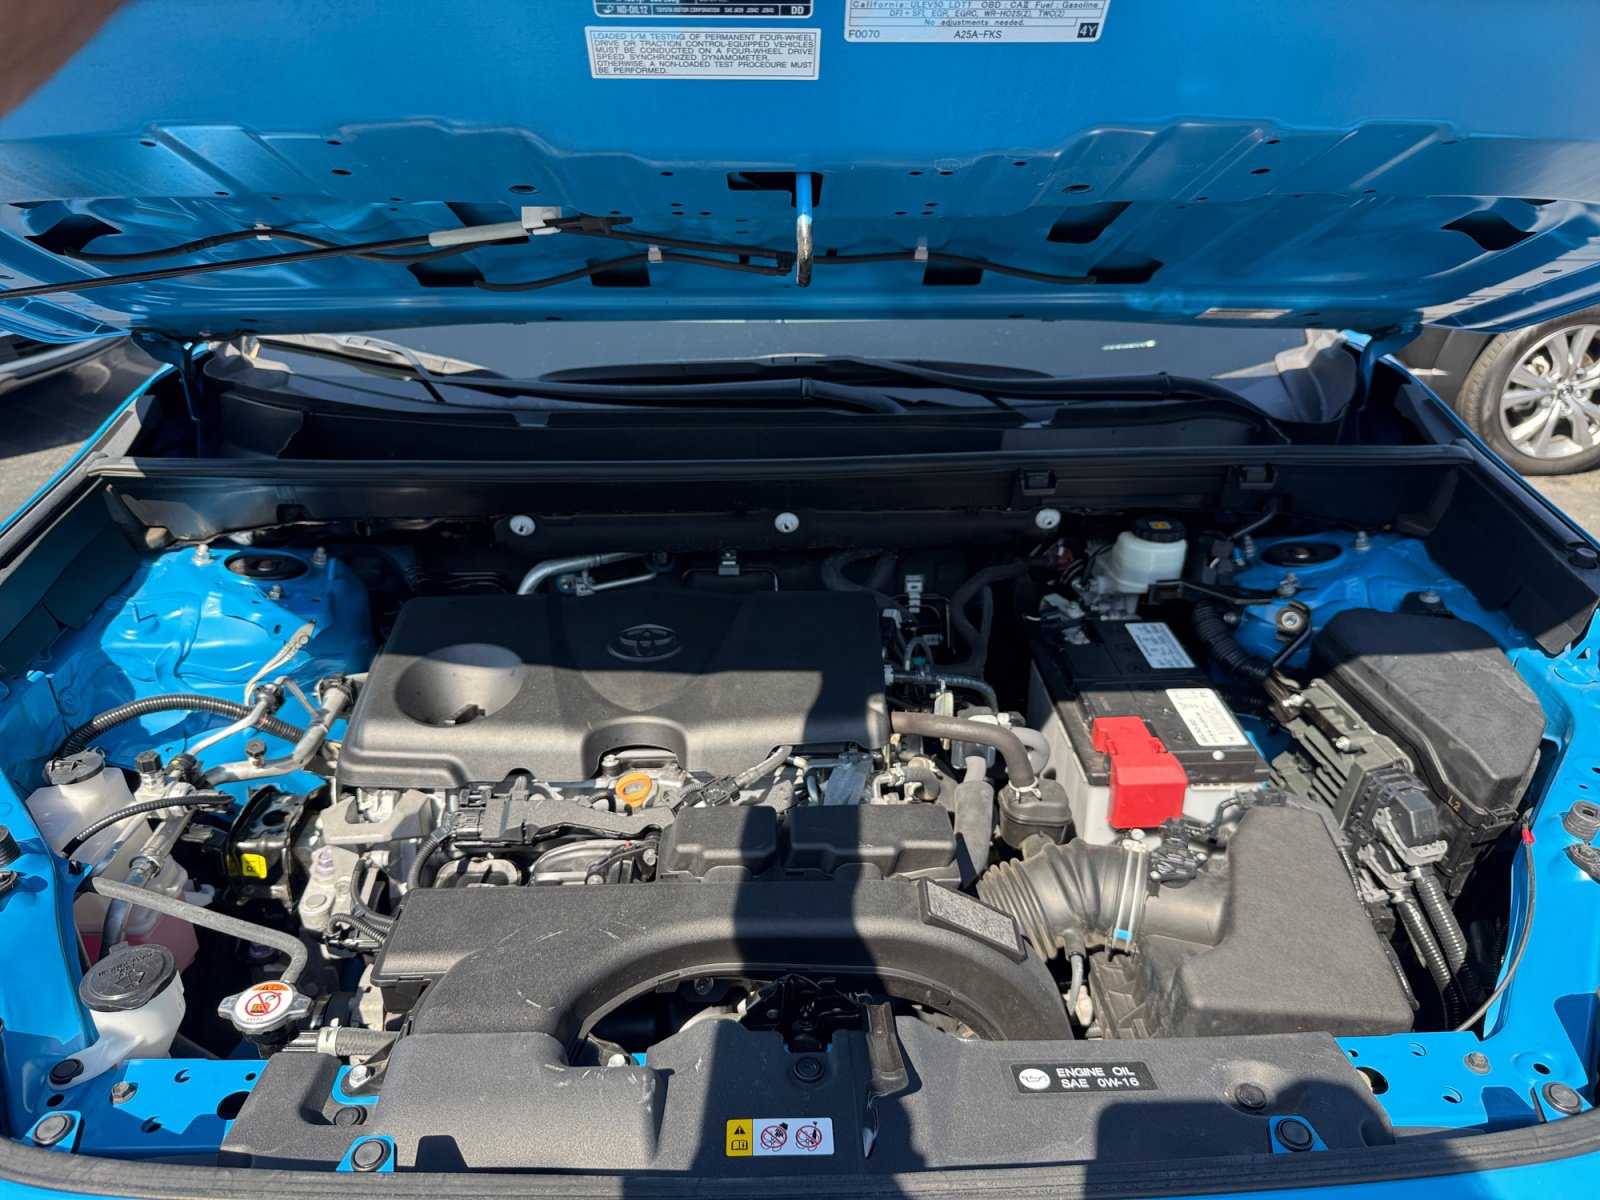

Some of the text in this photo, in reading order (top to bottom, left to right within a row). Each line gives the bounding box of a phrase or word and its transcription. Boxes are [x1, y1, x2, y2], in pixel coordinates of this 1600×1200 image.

[940, 18, 989, 26] adjustments
[848, 29, 880, 38] F0070
[953, 30, 1002, 38] A25A-FKS
[1079, 25, 1097, 36] 4Y
[1447, 795, 1461, 812] L2
[1056, 1067, 1135, 1077] ENGINE OIL
[1062, 1078, 1139, 1088] SAE 0W-16
